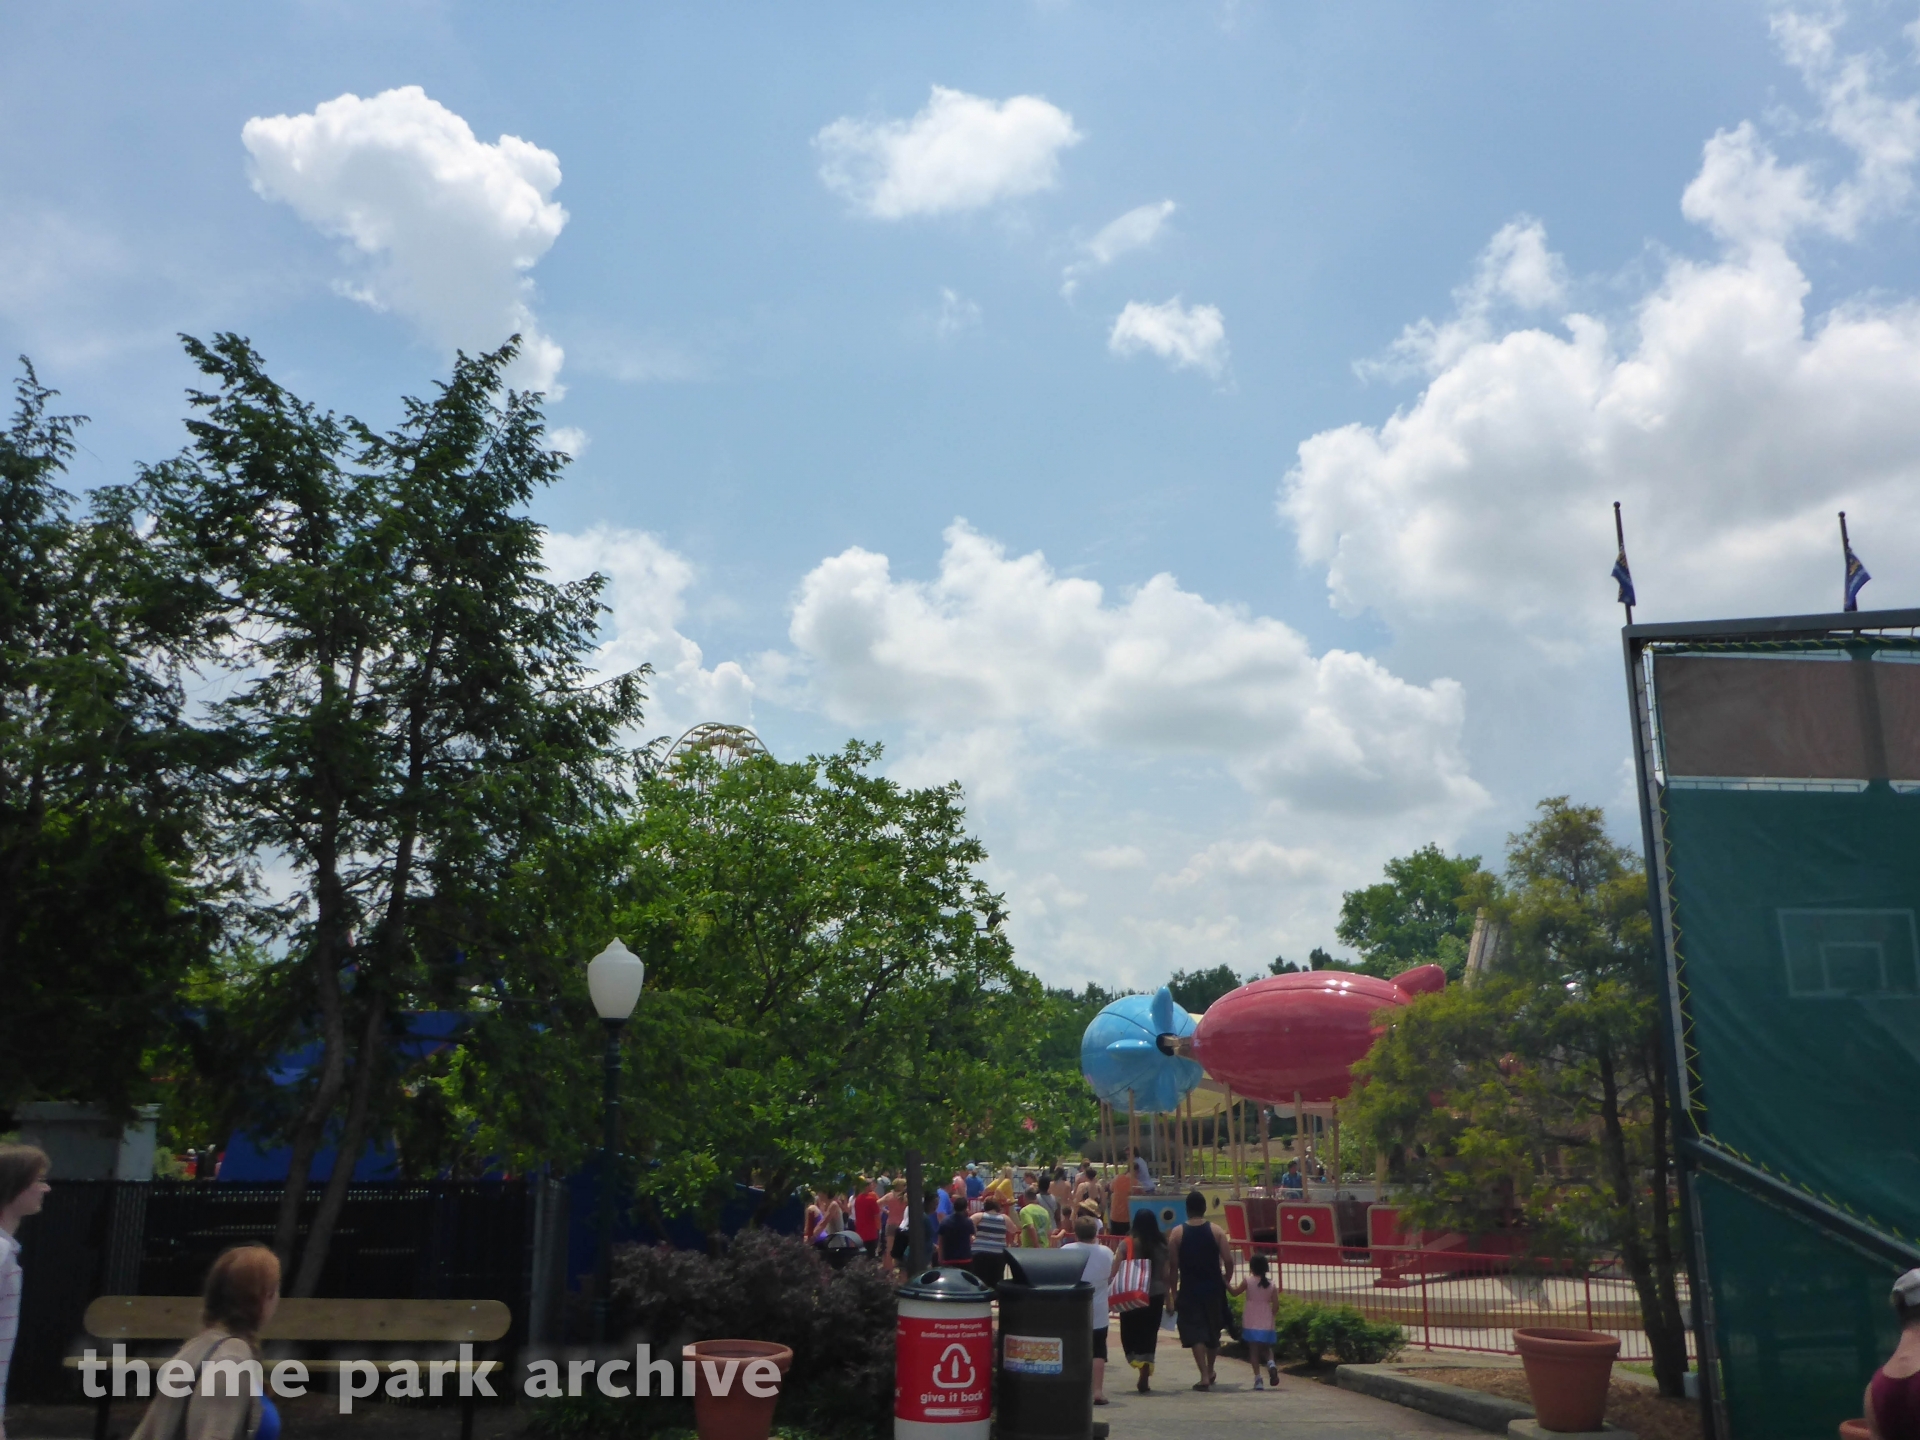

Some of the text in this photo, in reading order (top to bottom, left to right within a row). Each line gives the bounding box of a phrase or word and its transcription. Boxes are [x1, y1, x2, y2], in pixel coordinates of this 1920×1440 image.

[920, 1390, 983, 1404] give it back
